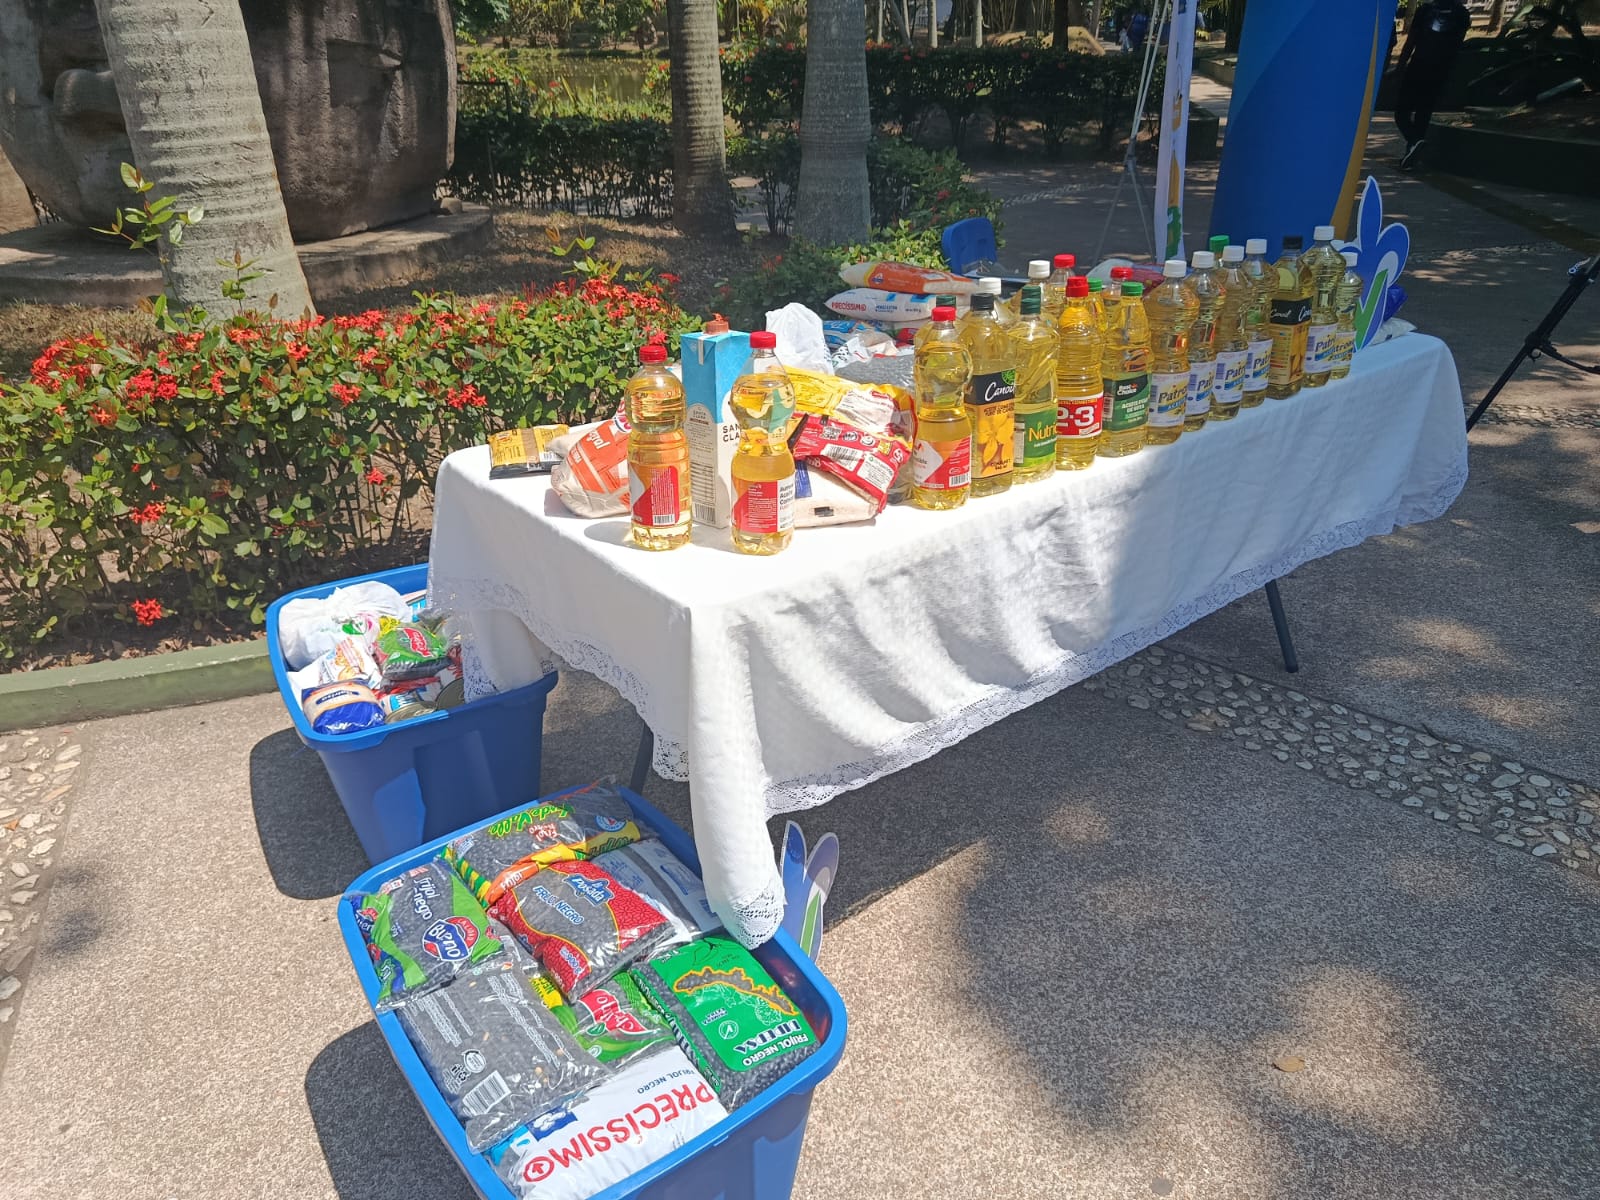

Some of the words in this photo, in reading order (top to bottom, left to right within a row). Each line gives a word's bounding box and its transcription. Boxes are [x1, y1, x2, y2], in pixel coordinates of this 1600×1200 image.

[722, 423, 741, 434] SAN
[722, 432, 740, 442] CLA
[414, 877, 441, 899] frijol
[572, 878, 605, 902] Posada
[555, 900, 585, 925] NEGRO
[779, 1033, 809, 1050] FRIJOL
[742, 1045, 780, 1067] NEGRO
[637, 1076, 668, 1095] NEGRO
